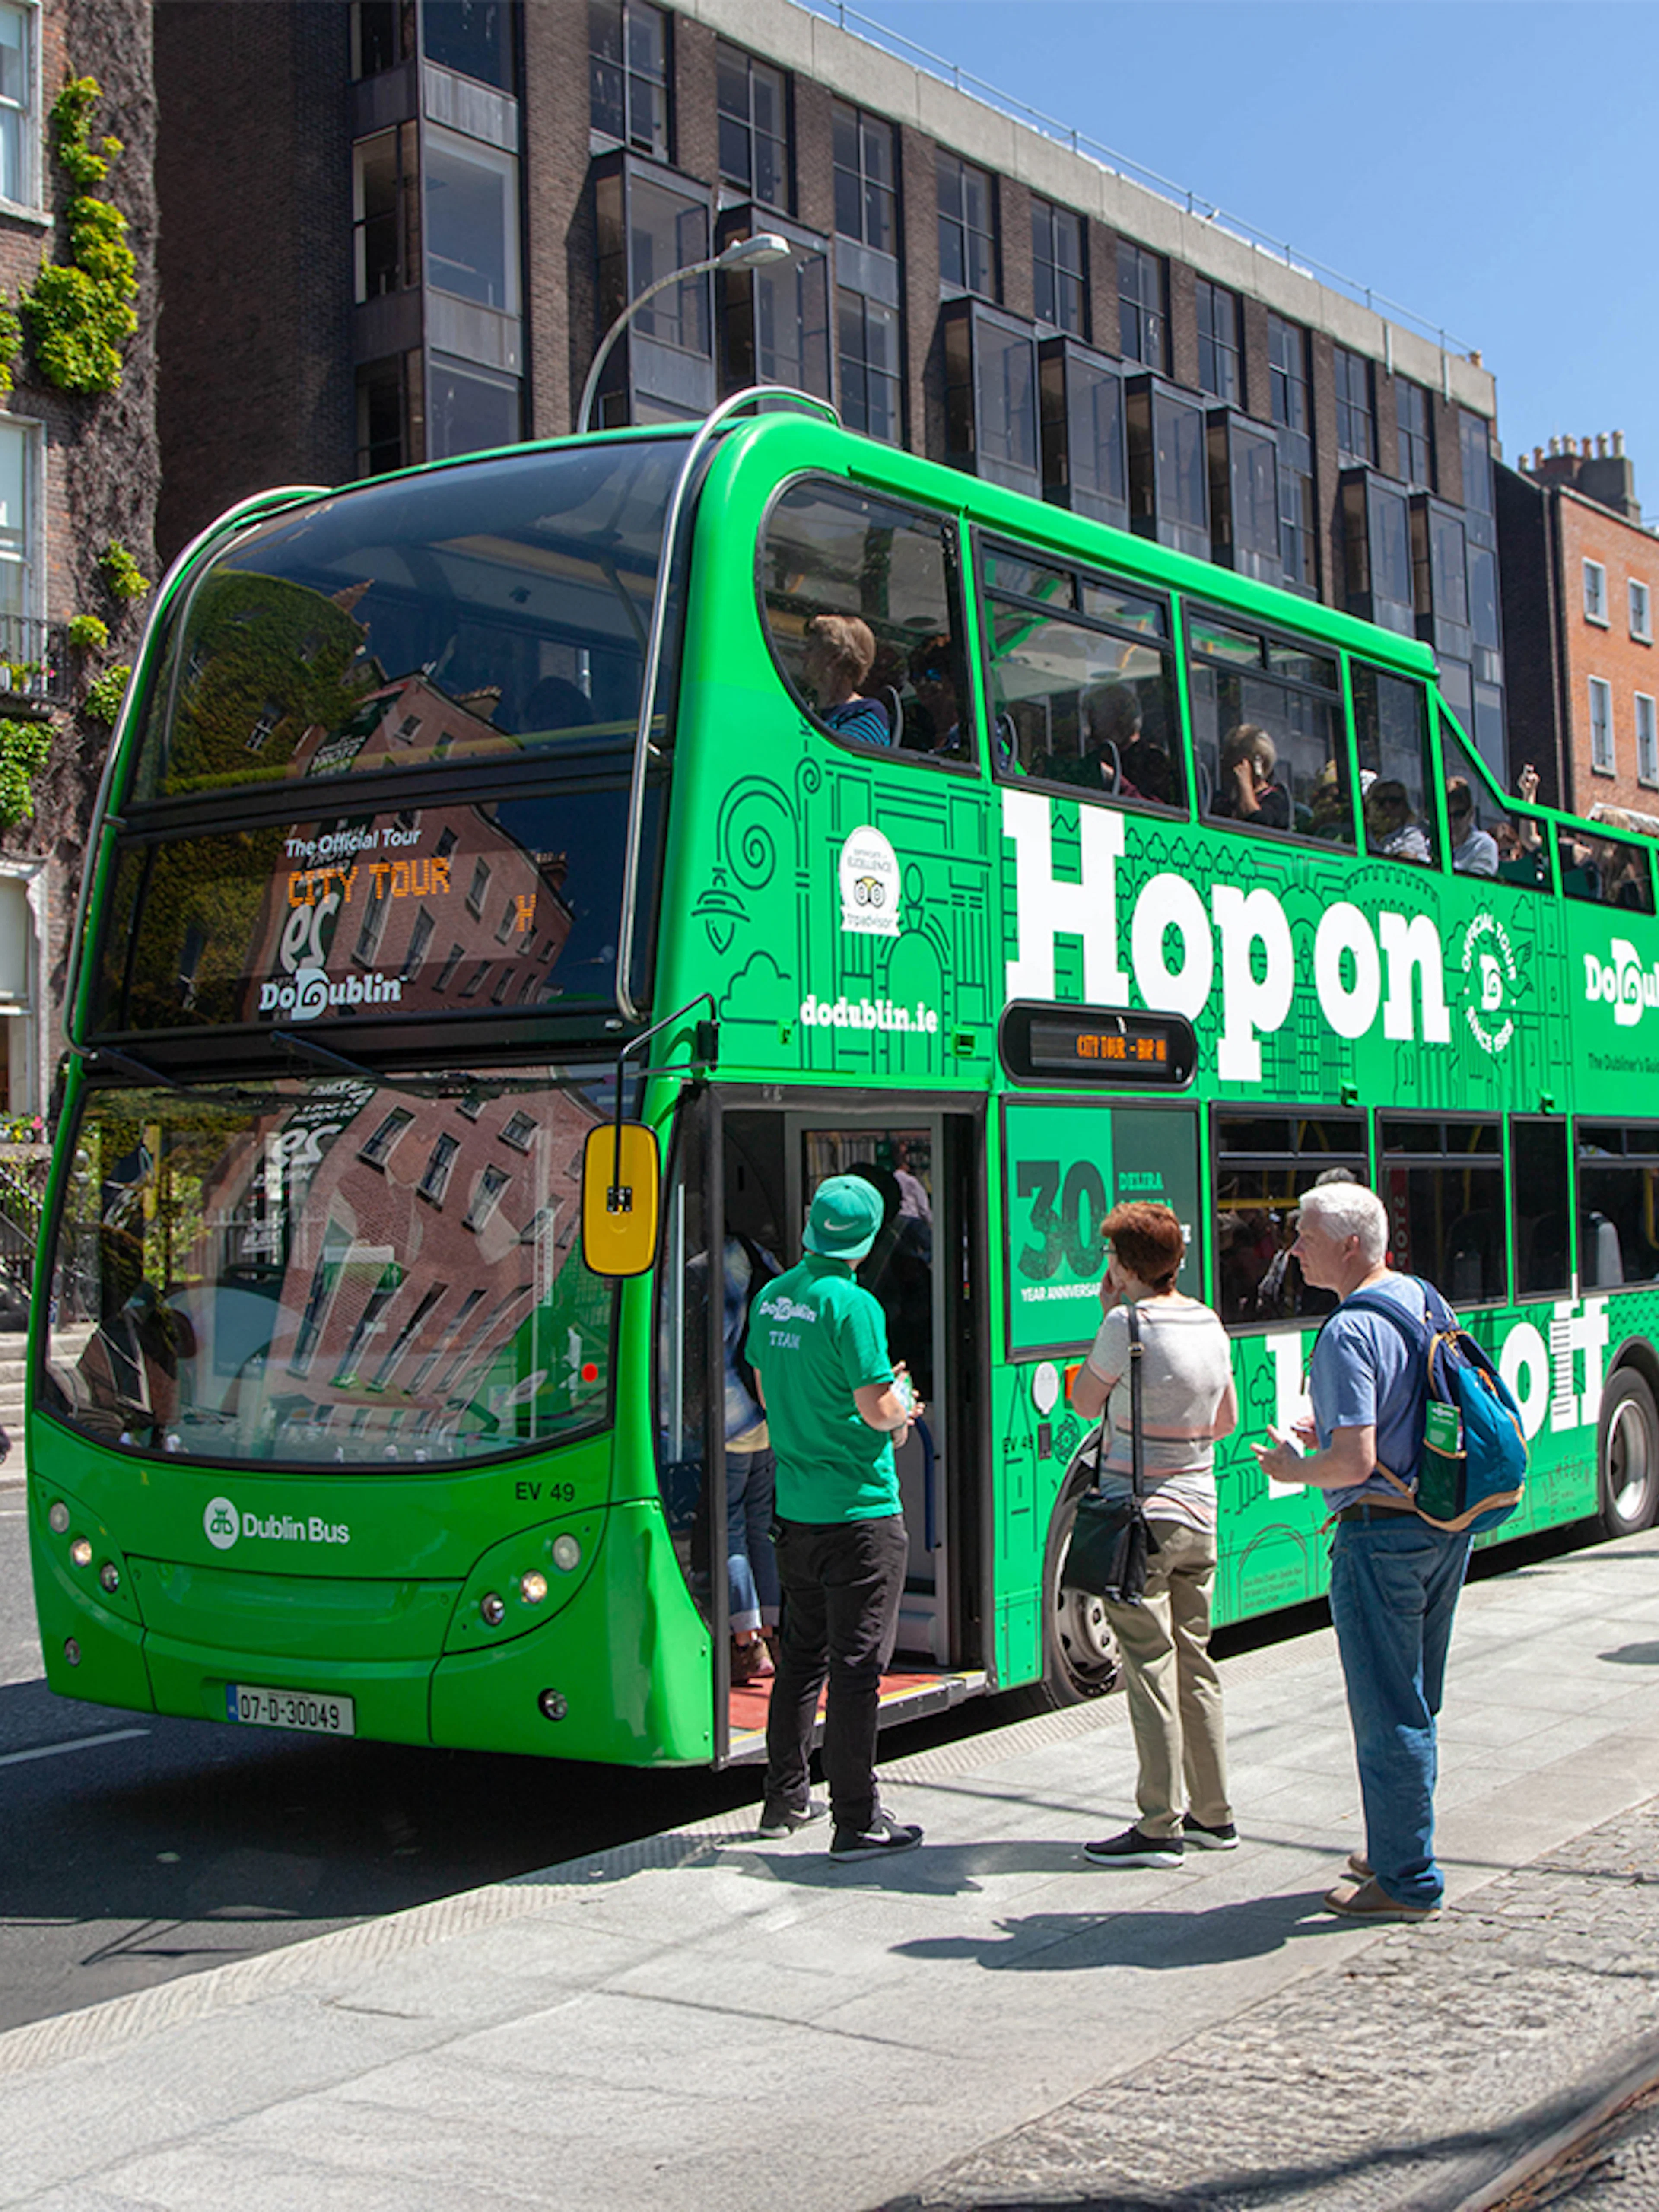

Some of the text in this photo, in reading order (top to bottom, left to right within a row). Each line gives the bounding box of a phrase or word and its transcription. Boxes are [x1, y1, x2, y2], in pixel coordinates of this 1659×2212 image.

[286, 828, 421, 858] The Official Tour
[288, 857, 450, 907] CITY TOUR
[1001, 788, 1451, 1082] Hop on
[260, 968, 402, 1021] DoDublin
[800, 994, 938, 1034] dodublin.ie
[1016, 1160, 1107, 1281] 30
[1021, 1286, 1046, 1302] YEAR
[1002, 1436, 1017, 1454] EV
[515, 1482, 575, 1503] EV 49
[242, 1513, 350, 1545] Dublin Bus
[241, 1694, 339, 1729] 07-D-30049
